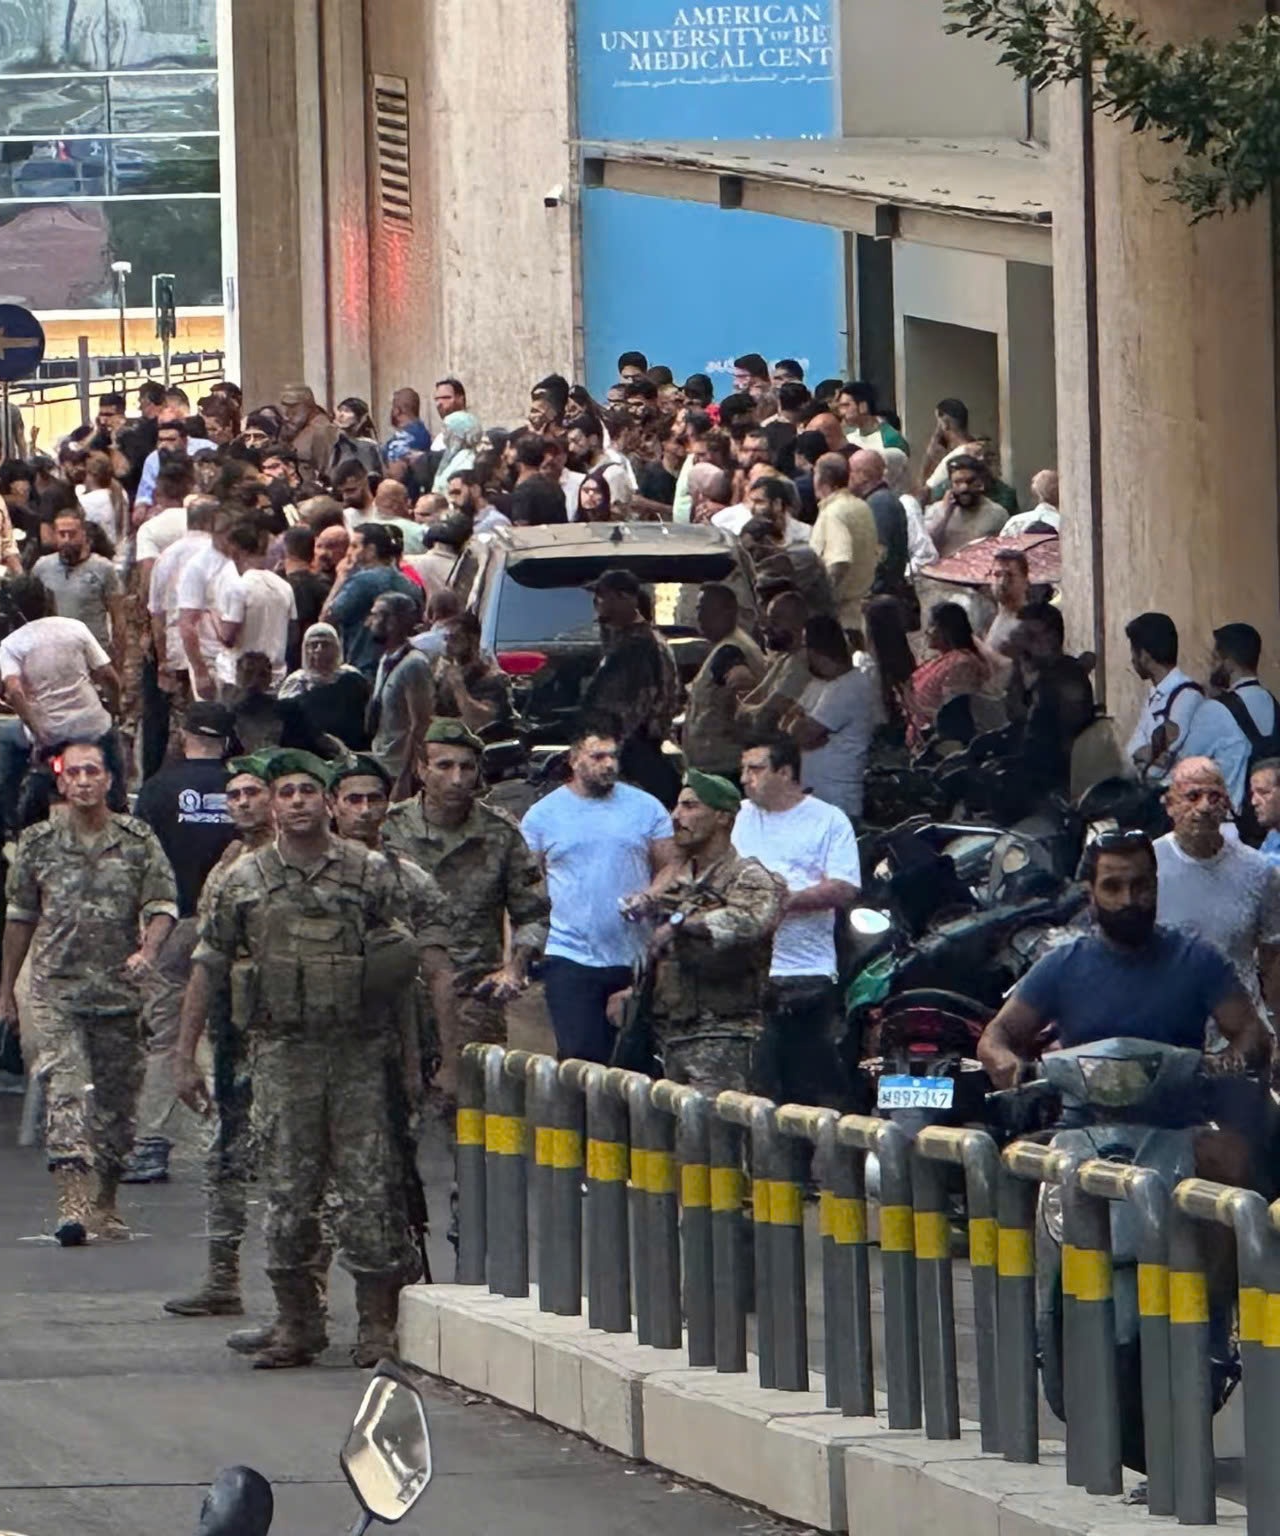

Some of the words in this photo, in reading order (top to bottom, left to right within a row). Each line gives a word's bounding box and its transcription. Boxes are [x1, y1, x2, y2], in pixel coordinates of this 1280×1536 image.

[673, 3, 821, 26] AMERICAN
[600, 26, 768, 52] UNIVERSITY
[628, 48, 752, 71] MEDICAL
